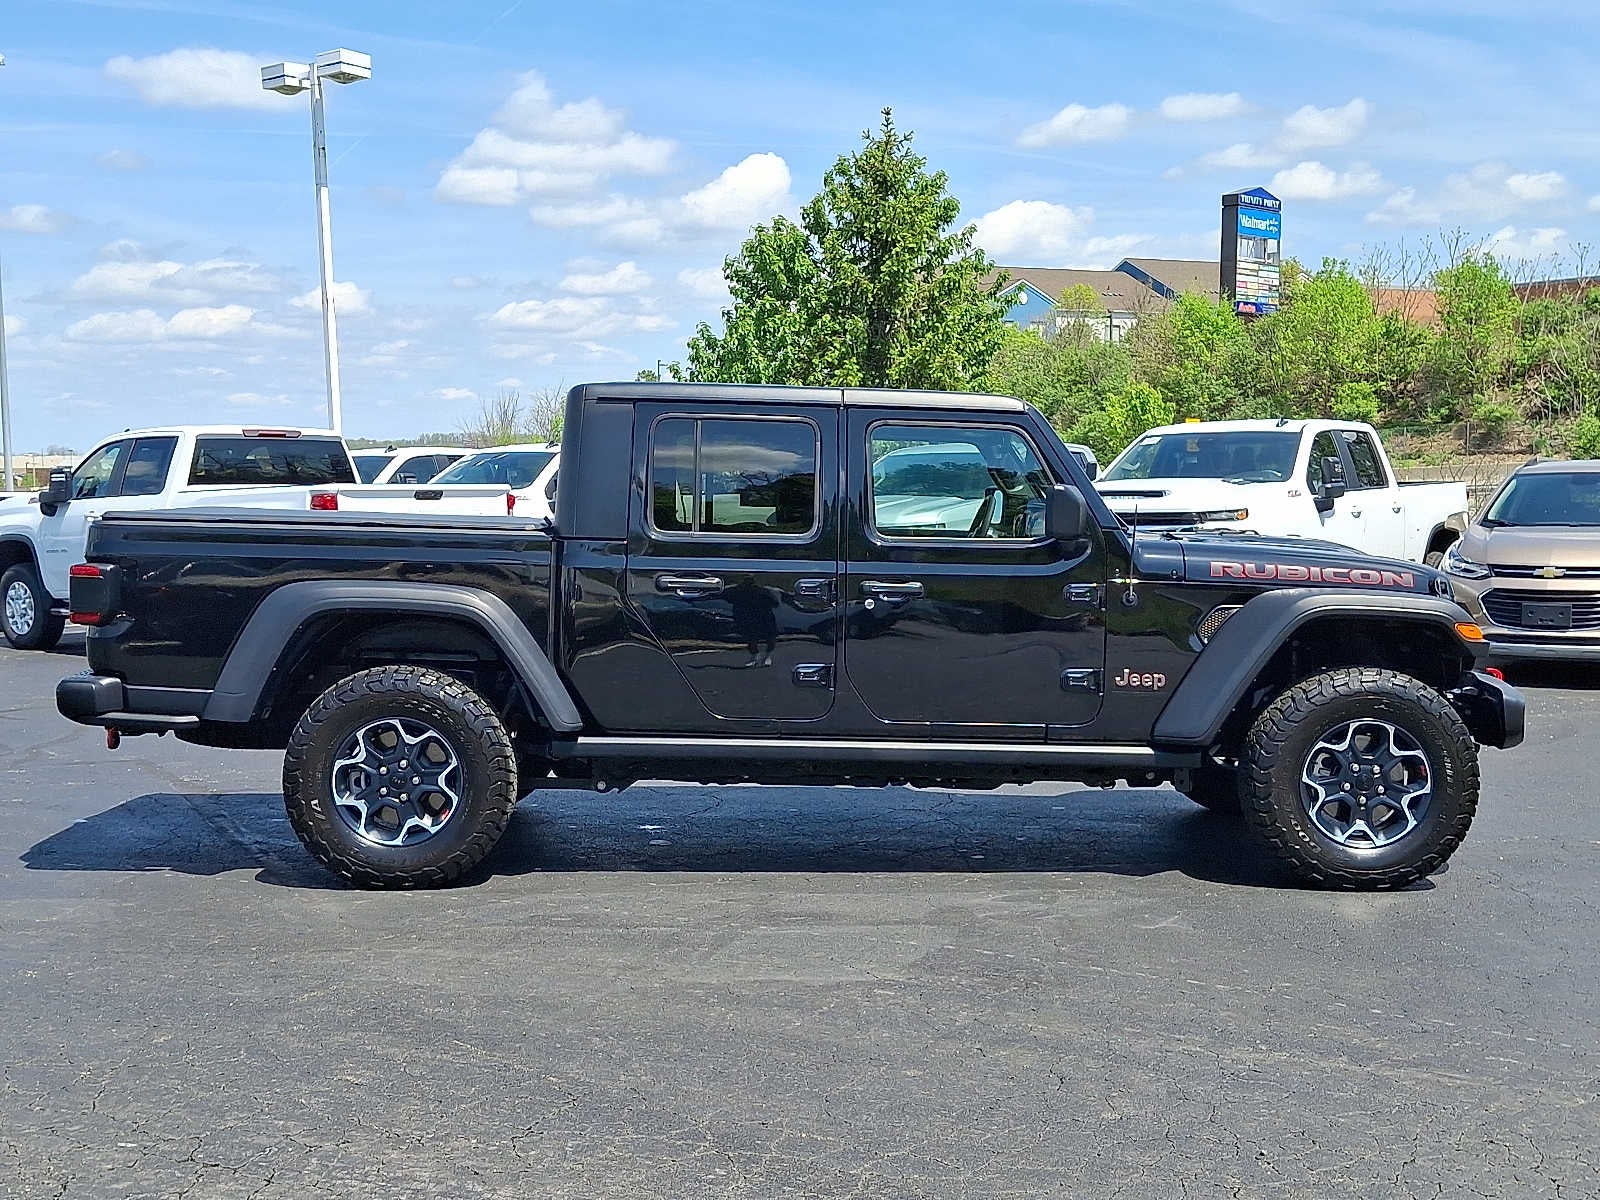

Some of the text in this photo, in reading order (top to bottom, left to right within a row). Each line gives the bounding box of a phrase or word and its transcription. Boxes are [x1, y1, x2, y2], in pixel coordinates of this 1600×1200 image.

[1241, 195, 1263, 206] TRINITY
[1240, 214, 1270, 231] Walmart
[1210, 562, 1415, 587] RUBICON
[1114, 668, 1166, 691] Jeep
